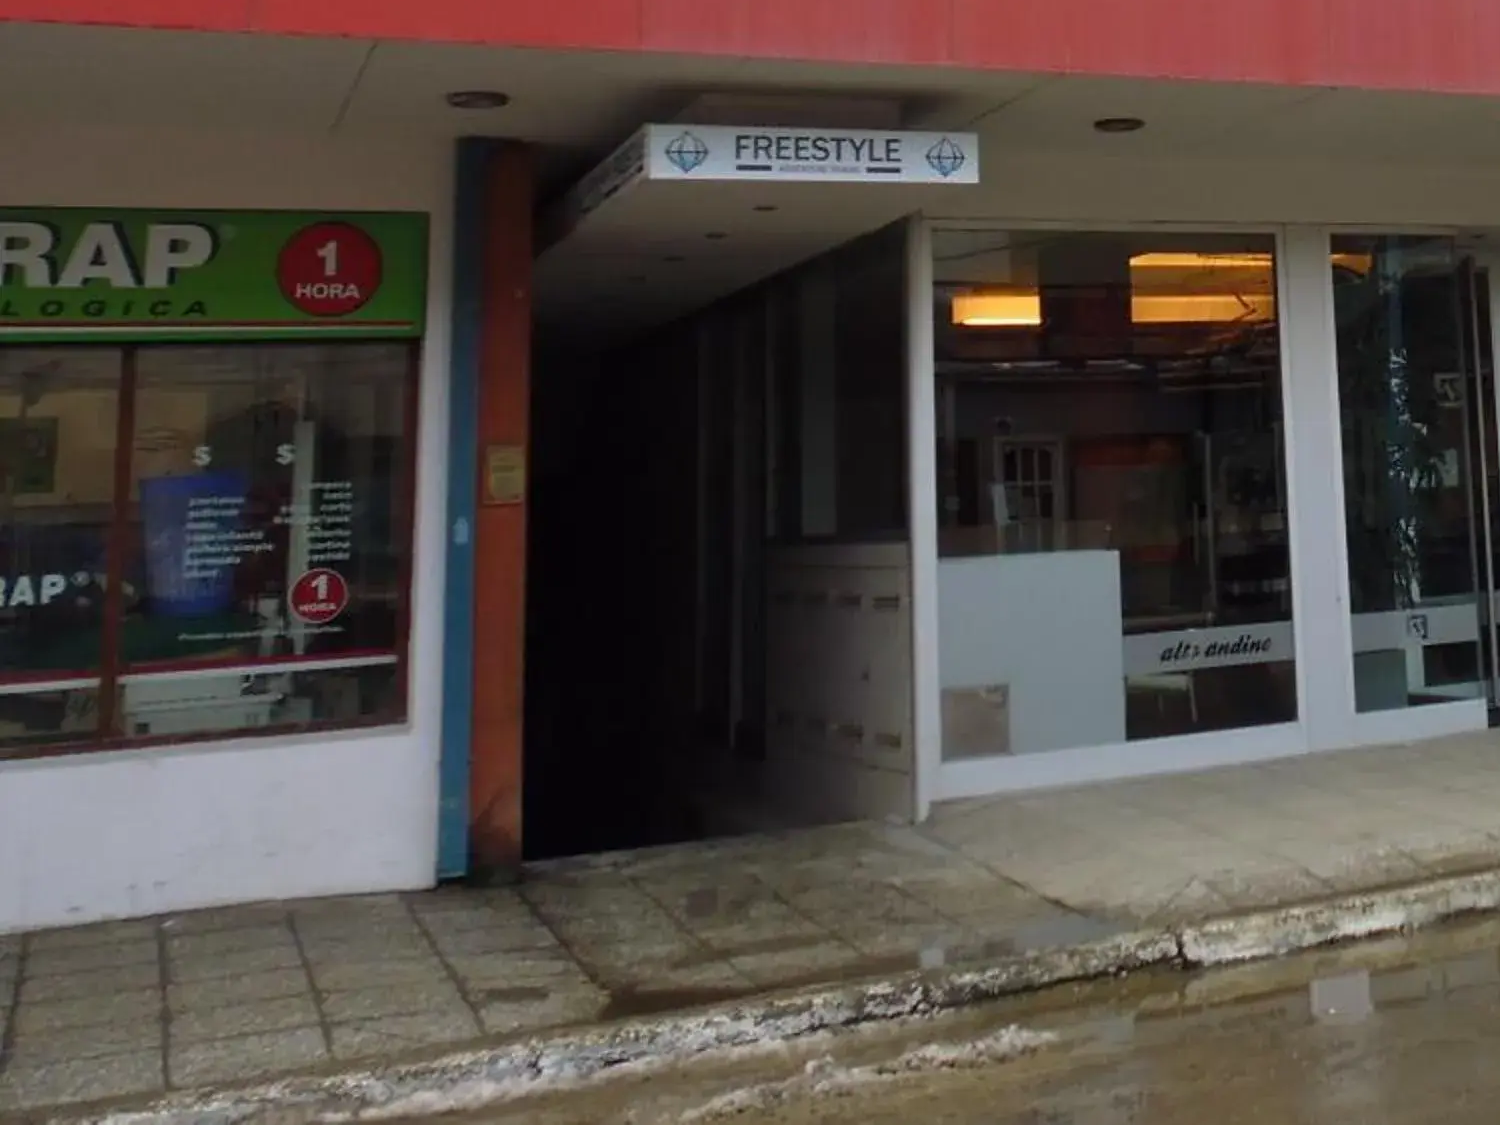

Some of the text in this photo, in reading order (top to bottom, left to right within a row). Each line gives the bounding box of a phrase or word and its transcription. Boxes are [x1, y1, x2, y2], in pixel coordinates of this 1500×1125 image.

[735, 135, 903, 163] FREESTYLE
[316, 240, 339, 276] 1
[295, 283, 360, 299] HORA
[0, 299, 209, 317] LOGICA
[0, 574, 67, 606] AP
[311, 574, 328, 600] 1
